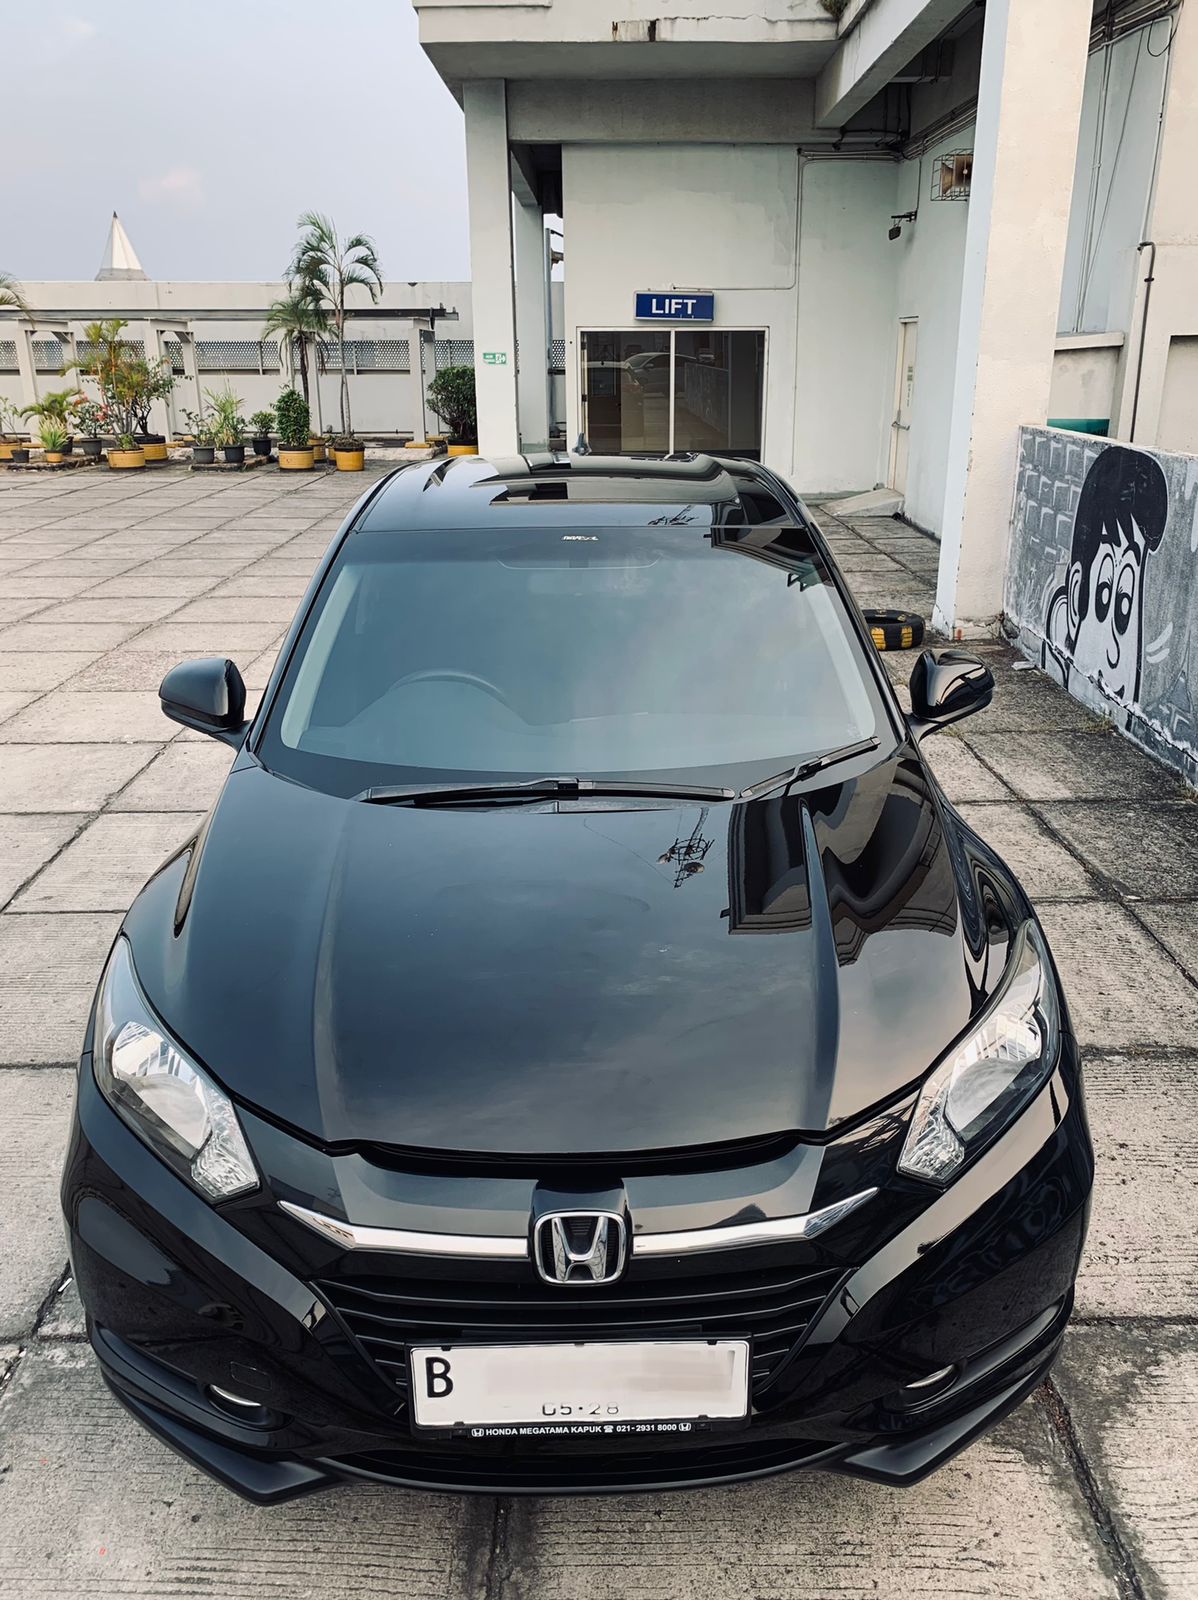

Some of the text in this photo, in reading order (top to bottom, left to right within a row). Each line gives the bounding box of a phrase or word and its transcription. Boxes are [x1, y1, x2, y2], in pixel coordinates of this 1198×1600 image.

[652, 299, 697, 314] LIFT
[425, 1357, 453, 1398] B
[486, 1428, 518, 1436] HONDA
[520, 1427, 569, 1435] MEGATAMA
[571, 1426, 602, 1434] KAPUK
[616, 1424, 655, 1432] 021-2931
